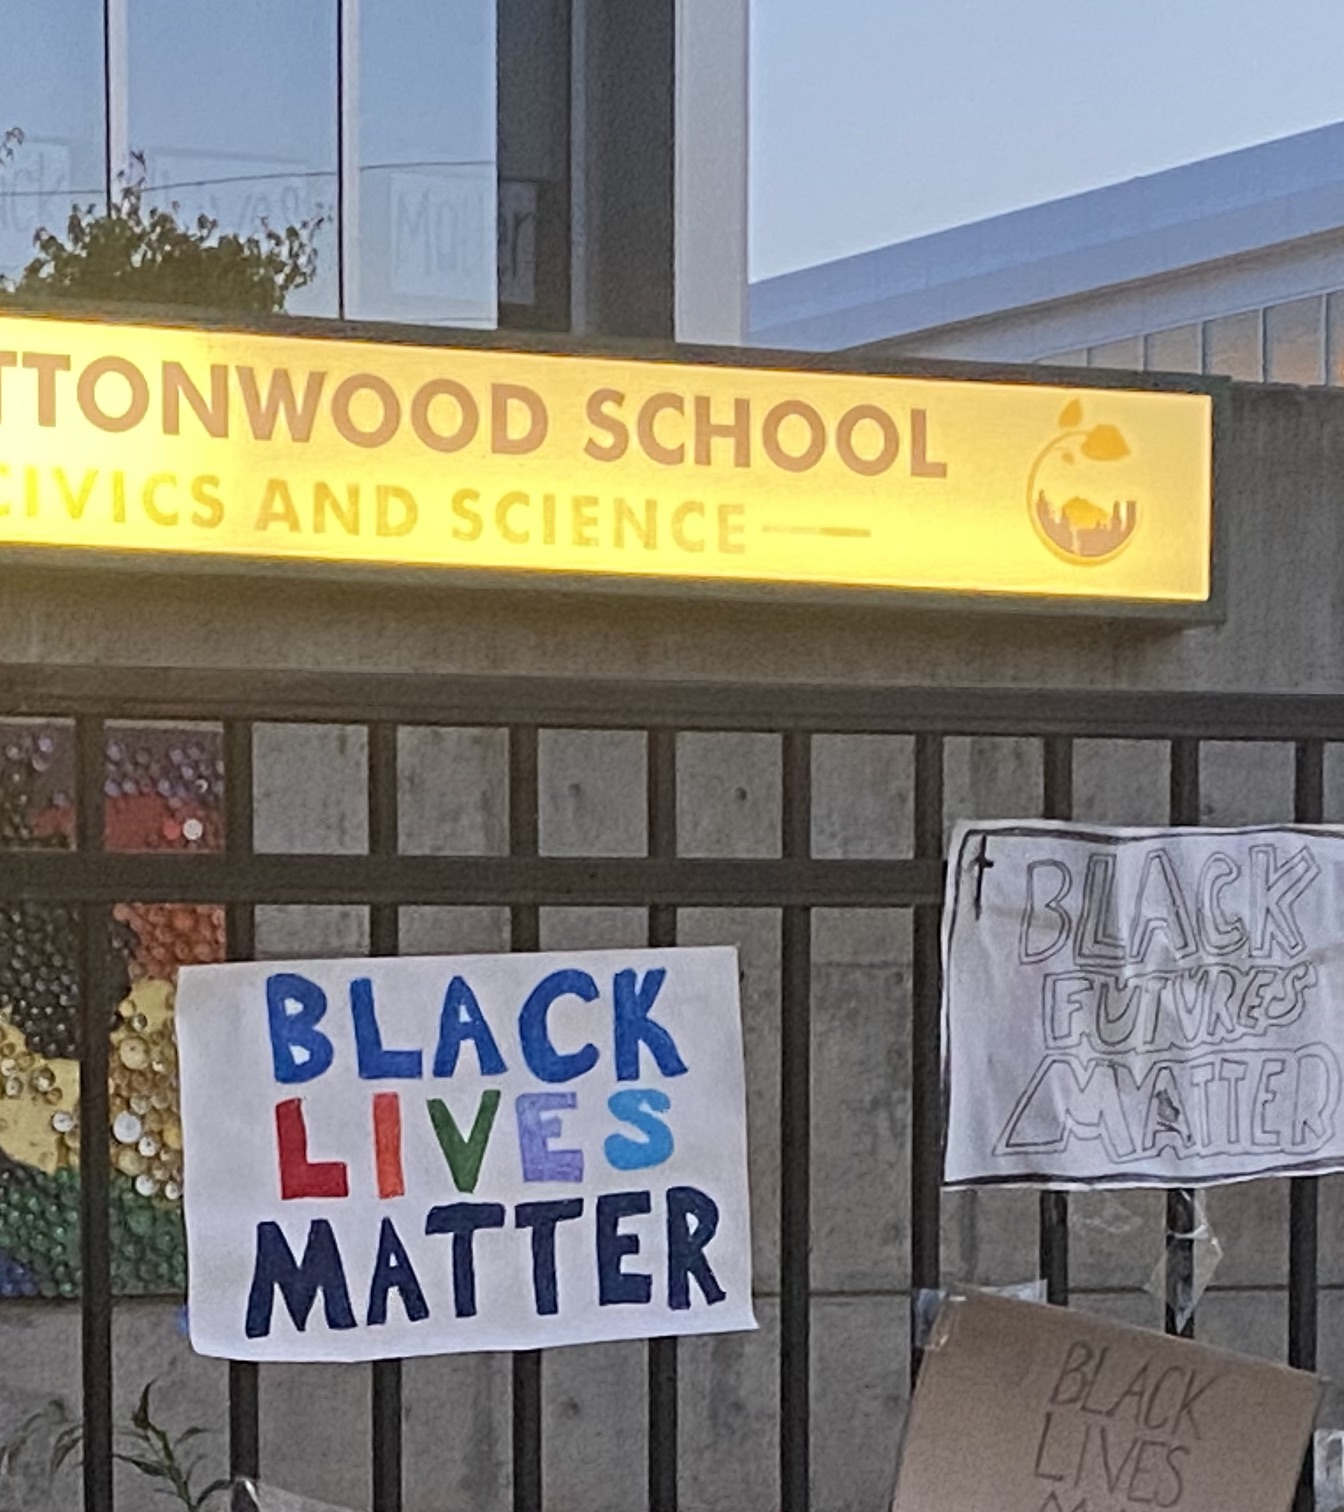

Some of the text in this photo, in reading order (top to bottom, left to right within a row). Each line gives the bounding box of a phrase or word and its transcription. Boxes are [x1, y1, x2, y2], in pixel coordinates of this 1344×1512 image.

[582, 388, 948, 480] SCHOOL
[255, 477, 419, 538] AND
[451, 488, 747, 555] SCIENCE
[1020, 843, 1321, 969] BLACK
[266, 967, 689, 1084] BLACK
[1042, 962, 1318, 1054] FUTURES
[274, 1088, 674, 1200] LIVES
[992, 1042, 1342, 1163] MATTER
[245, 1186, 727, 1339] MATTER
[1049, 1339, 1221, 1440] BLACK
[1033, 1411, 1190, 1508] LIVES
